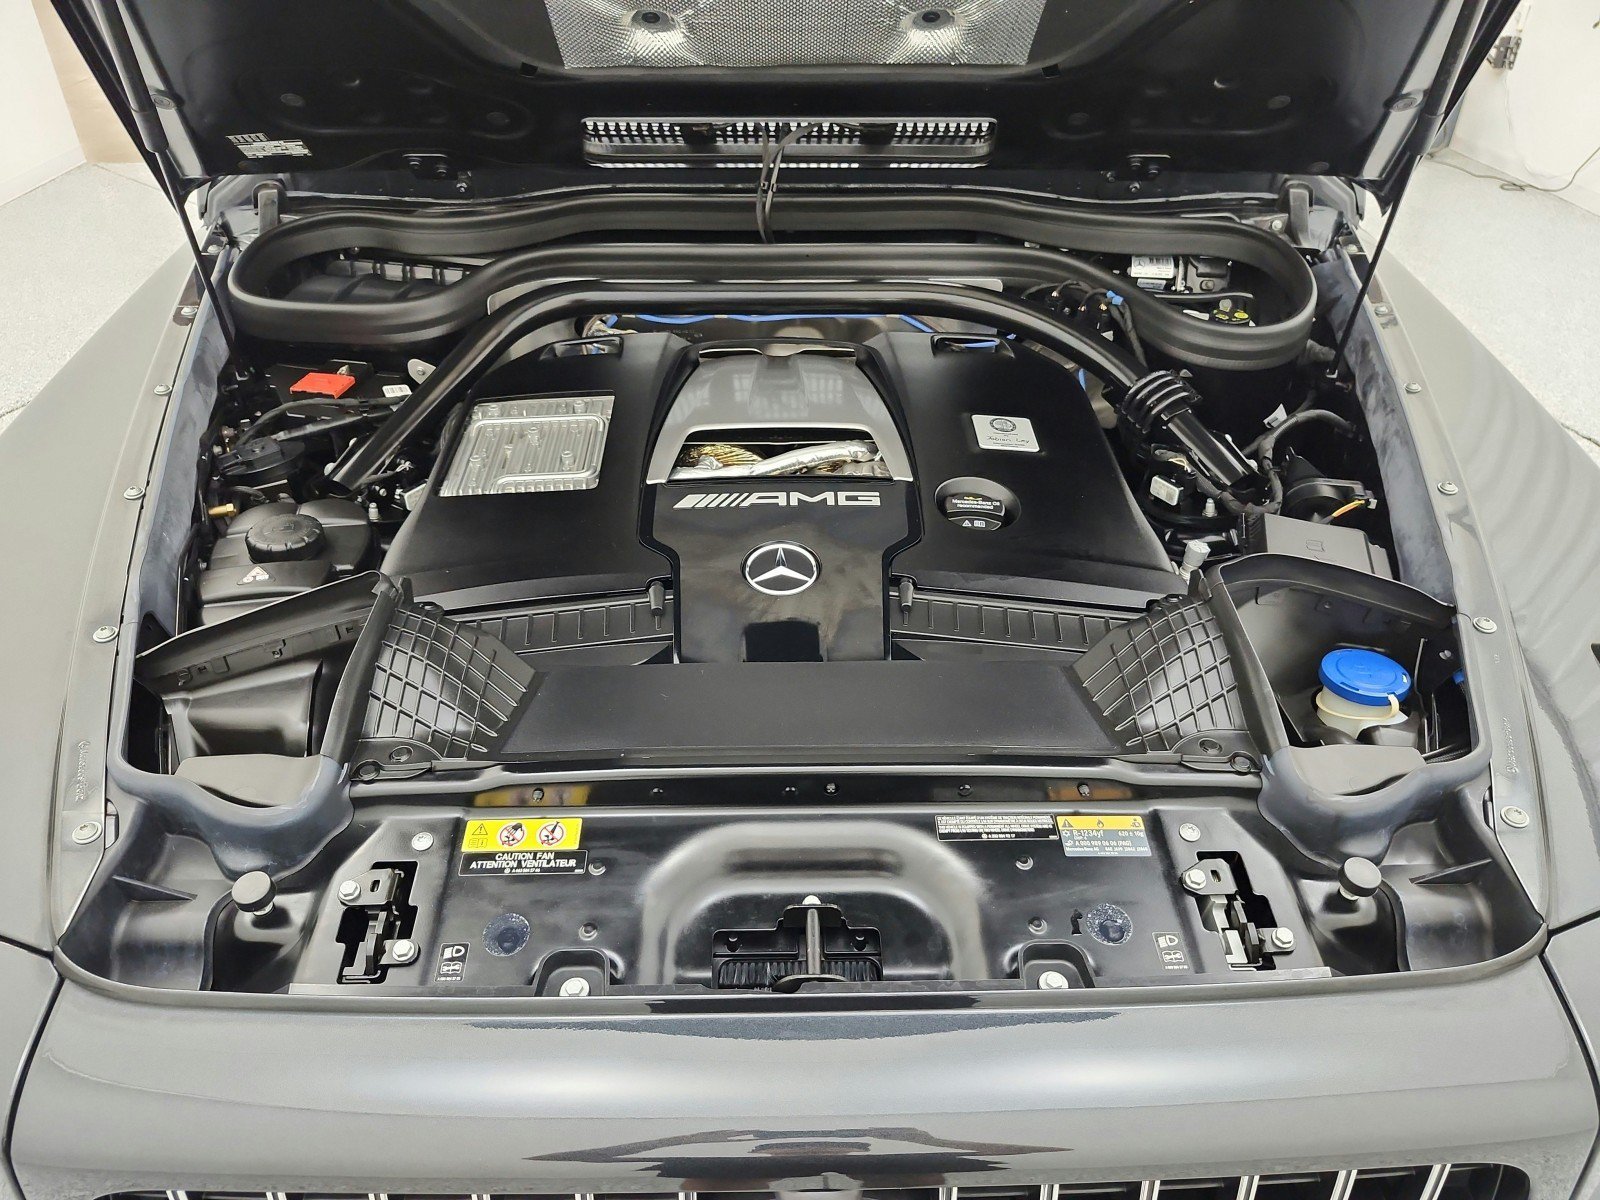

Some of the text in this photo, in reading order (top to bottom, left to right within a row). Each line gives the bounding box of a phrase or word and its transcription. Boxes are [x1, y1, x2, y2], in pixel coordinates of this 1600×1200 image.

[738, 491, 881, 508] AMG
[1072, 829, 1104, 838] R-1234yf
[495, 852, 555, 861] CAUTION FAN
[469, 859, 577, 869] ATTENTION VENTILATEUR
